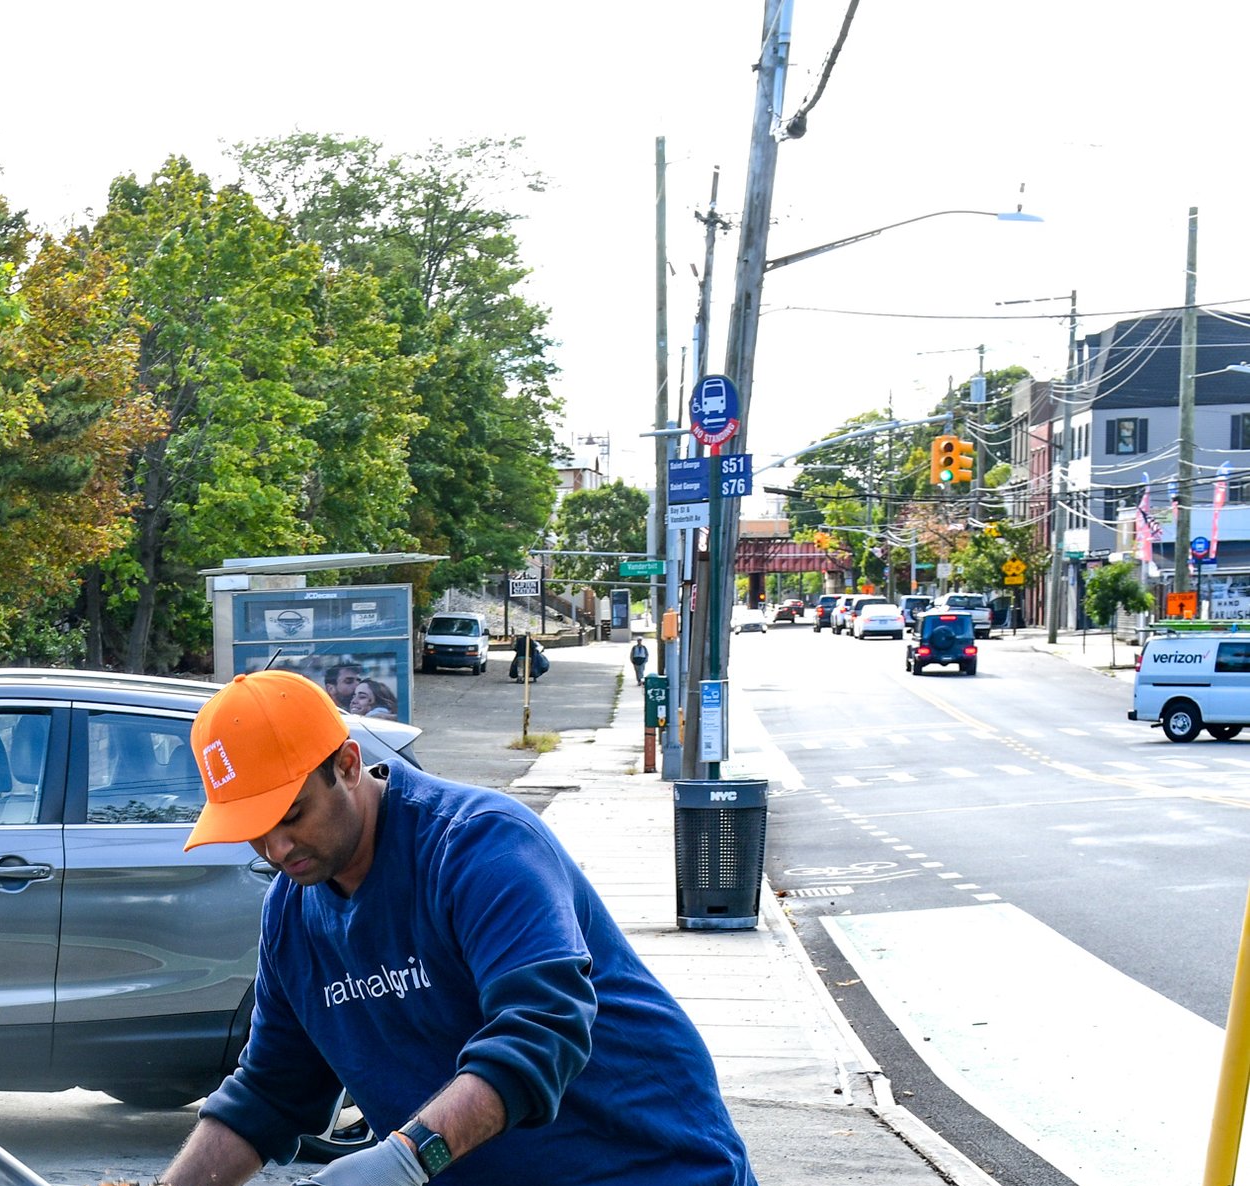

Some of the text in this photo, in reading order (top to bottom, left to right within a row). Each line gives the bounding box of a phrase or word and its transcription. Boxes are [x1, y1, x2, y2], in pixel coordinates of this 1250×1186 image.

[693, 422, 735, 444] NO STANDING
[683, 461, 700, 470] George
[722, 457, 744, 474] S51
[683, 482, 700, 491] George
[722, 478, 746, 495] S76
[513, 587, 537, 595] STATION
[1153, 650, 1202, 664] verizon
[710, 791, 737, 801] NYC
